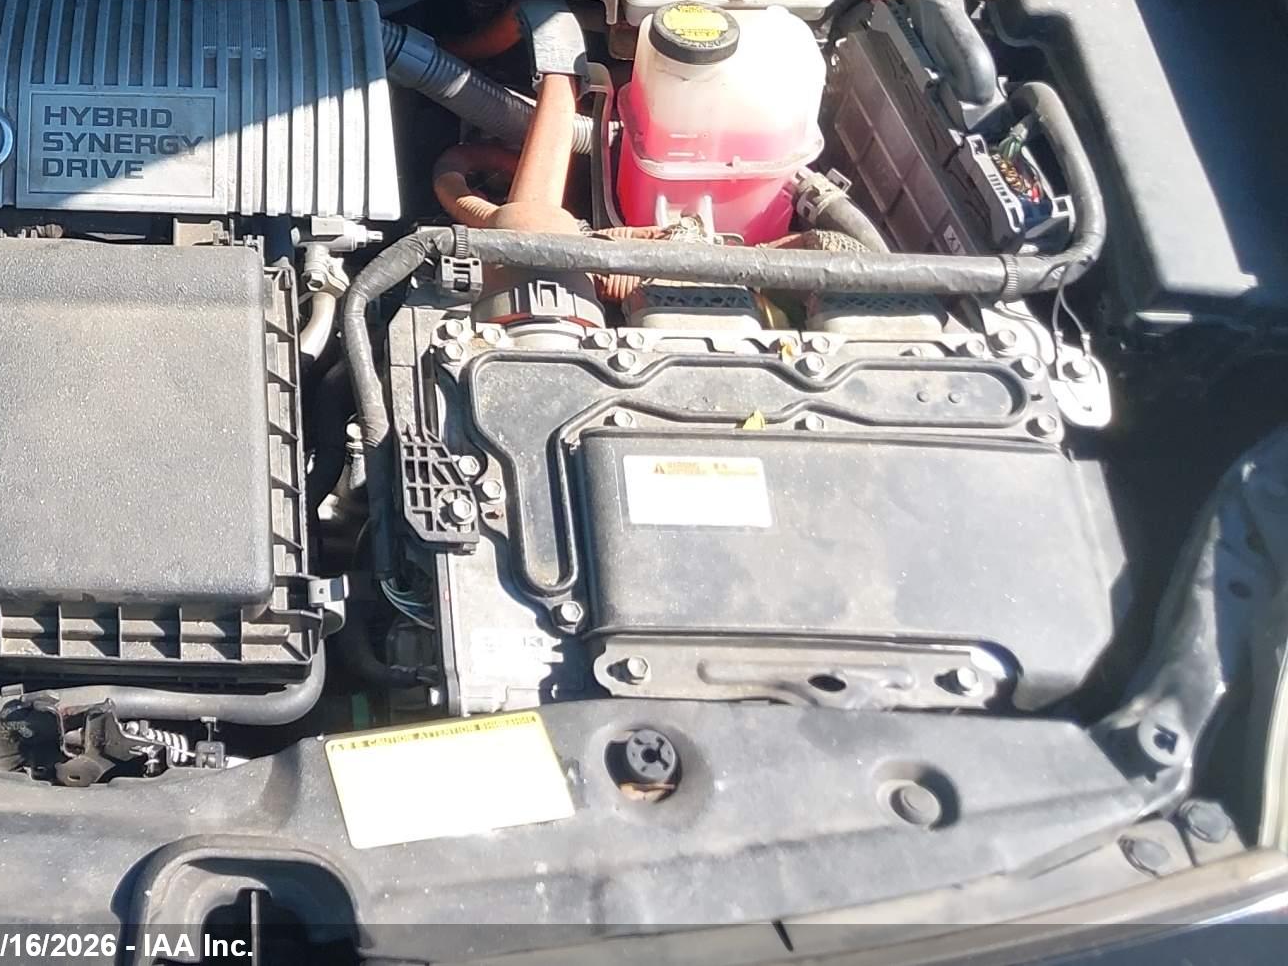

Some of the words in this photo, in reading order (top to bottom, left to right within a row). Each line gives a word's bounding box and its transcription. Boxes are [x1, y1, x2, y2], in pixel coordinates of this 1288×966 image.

[44, 105, 173, 129] HYBRID
[42, 131, 204, 155] SYNERGY
[42, 157, 145, 179] DRIVE
